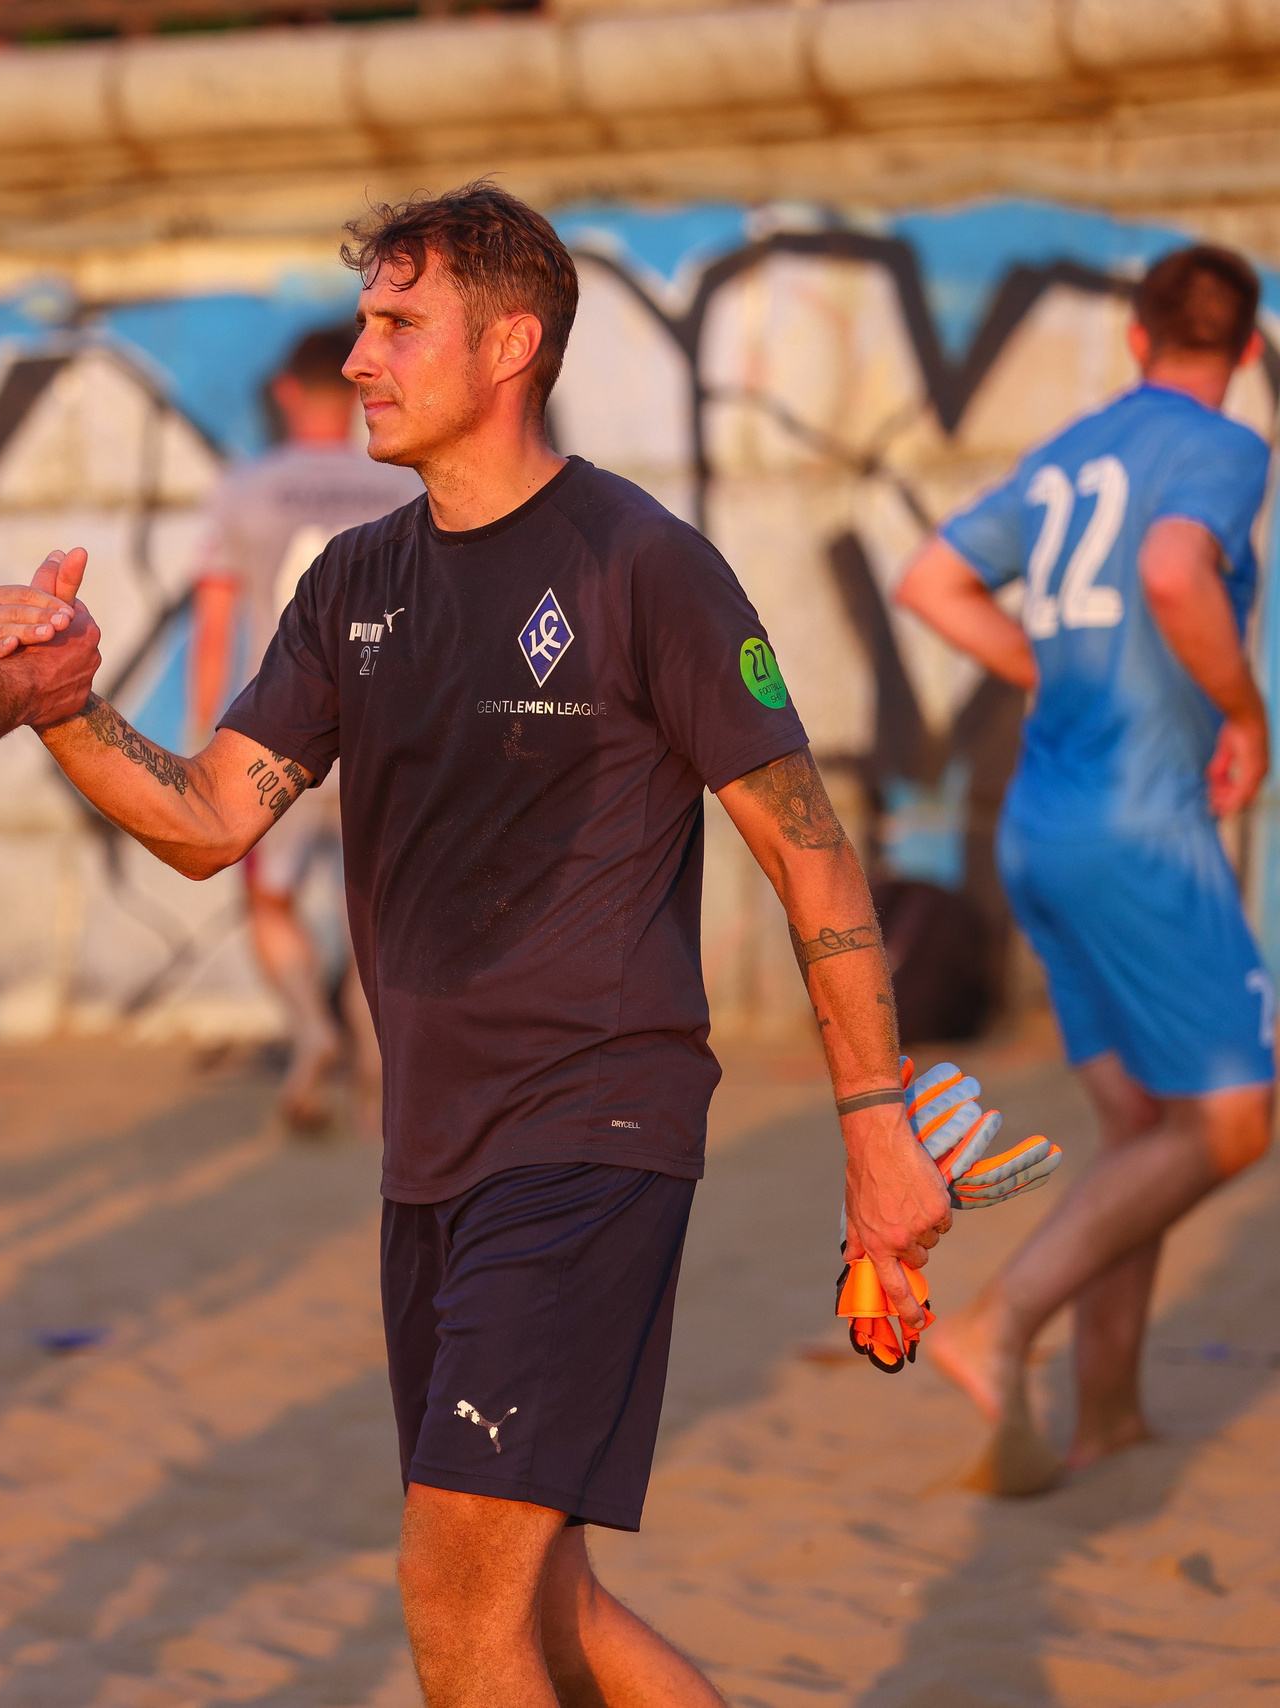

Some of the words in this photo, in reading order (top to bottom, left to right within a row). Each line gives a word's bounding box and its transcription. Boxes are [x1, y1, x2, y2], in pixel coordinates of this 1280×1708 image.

[1023, 455, 1129, 639] 22
[349, 622, 385, 642] PUM
[745, 643, 771, 683] 27
[476, 700, 554, 715] GENTLEMEN
[557, 701, 607, 716] LEAGUE
[611, 1119, 641, 1129] DRYCELL
